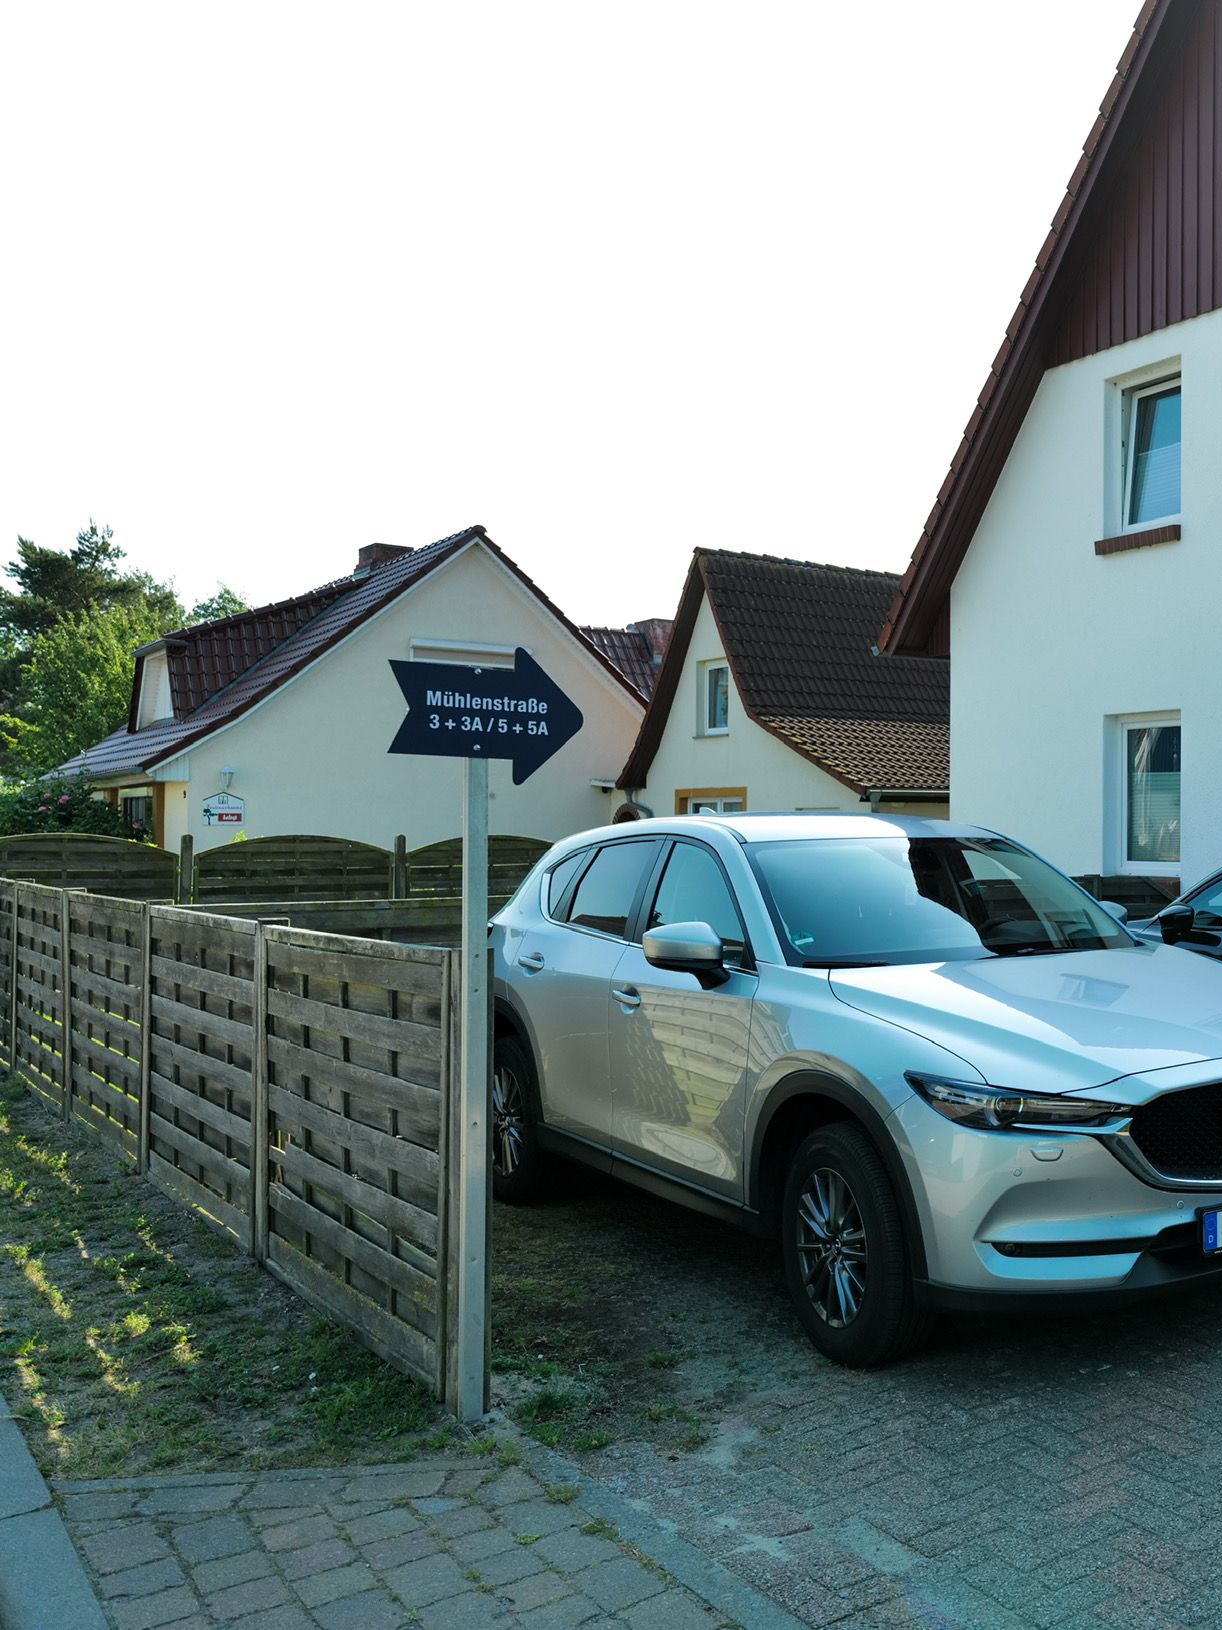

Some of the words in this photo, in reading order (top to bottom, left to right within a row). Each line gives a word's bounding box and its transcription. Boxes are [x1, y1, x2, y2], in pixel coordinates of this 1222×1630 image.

[426, 690, 548, 714] Mühlenstraße
[429, 714, 440, 729] 3
[461, 716, 483, 732] 3A
[498, 718, 508, 733] 5
[528, 721, 549, 736] 5A
[1208, 1234, 1214, 1244] D
